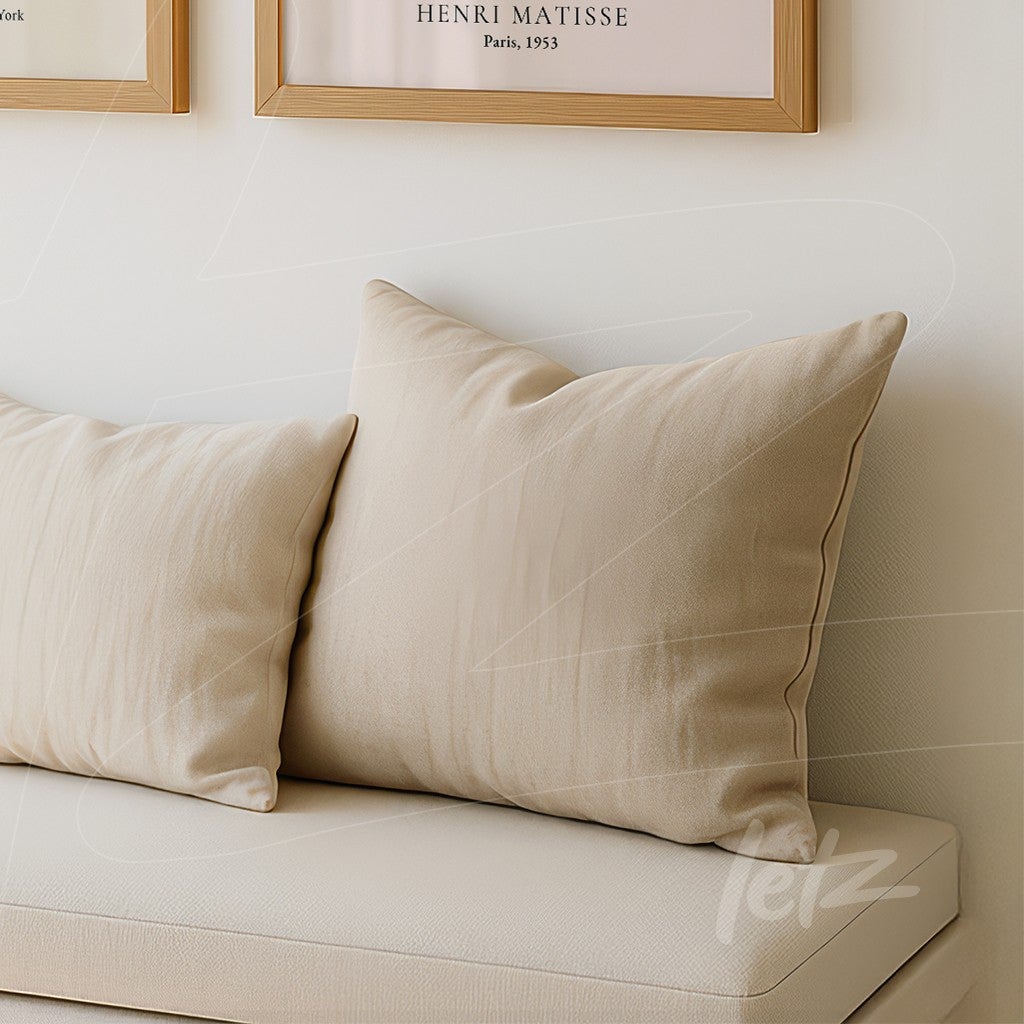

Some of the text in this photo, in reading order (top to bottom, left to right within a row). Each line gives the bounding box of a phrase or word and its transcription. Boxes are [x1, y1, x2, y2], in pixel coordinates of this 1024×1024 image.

[416, 3, 629, 27] HENRI MATISSE
[483, 34, 559, 51] Paris, 1953
